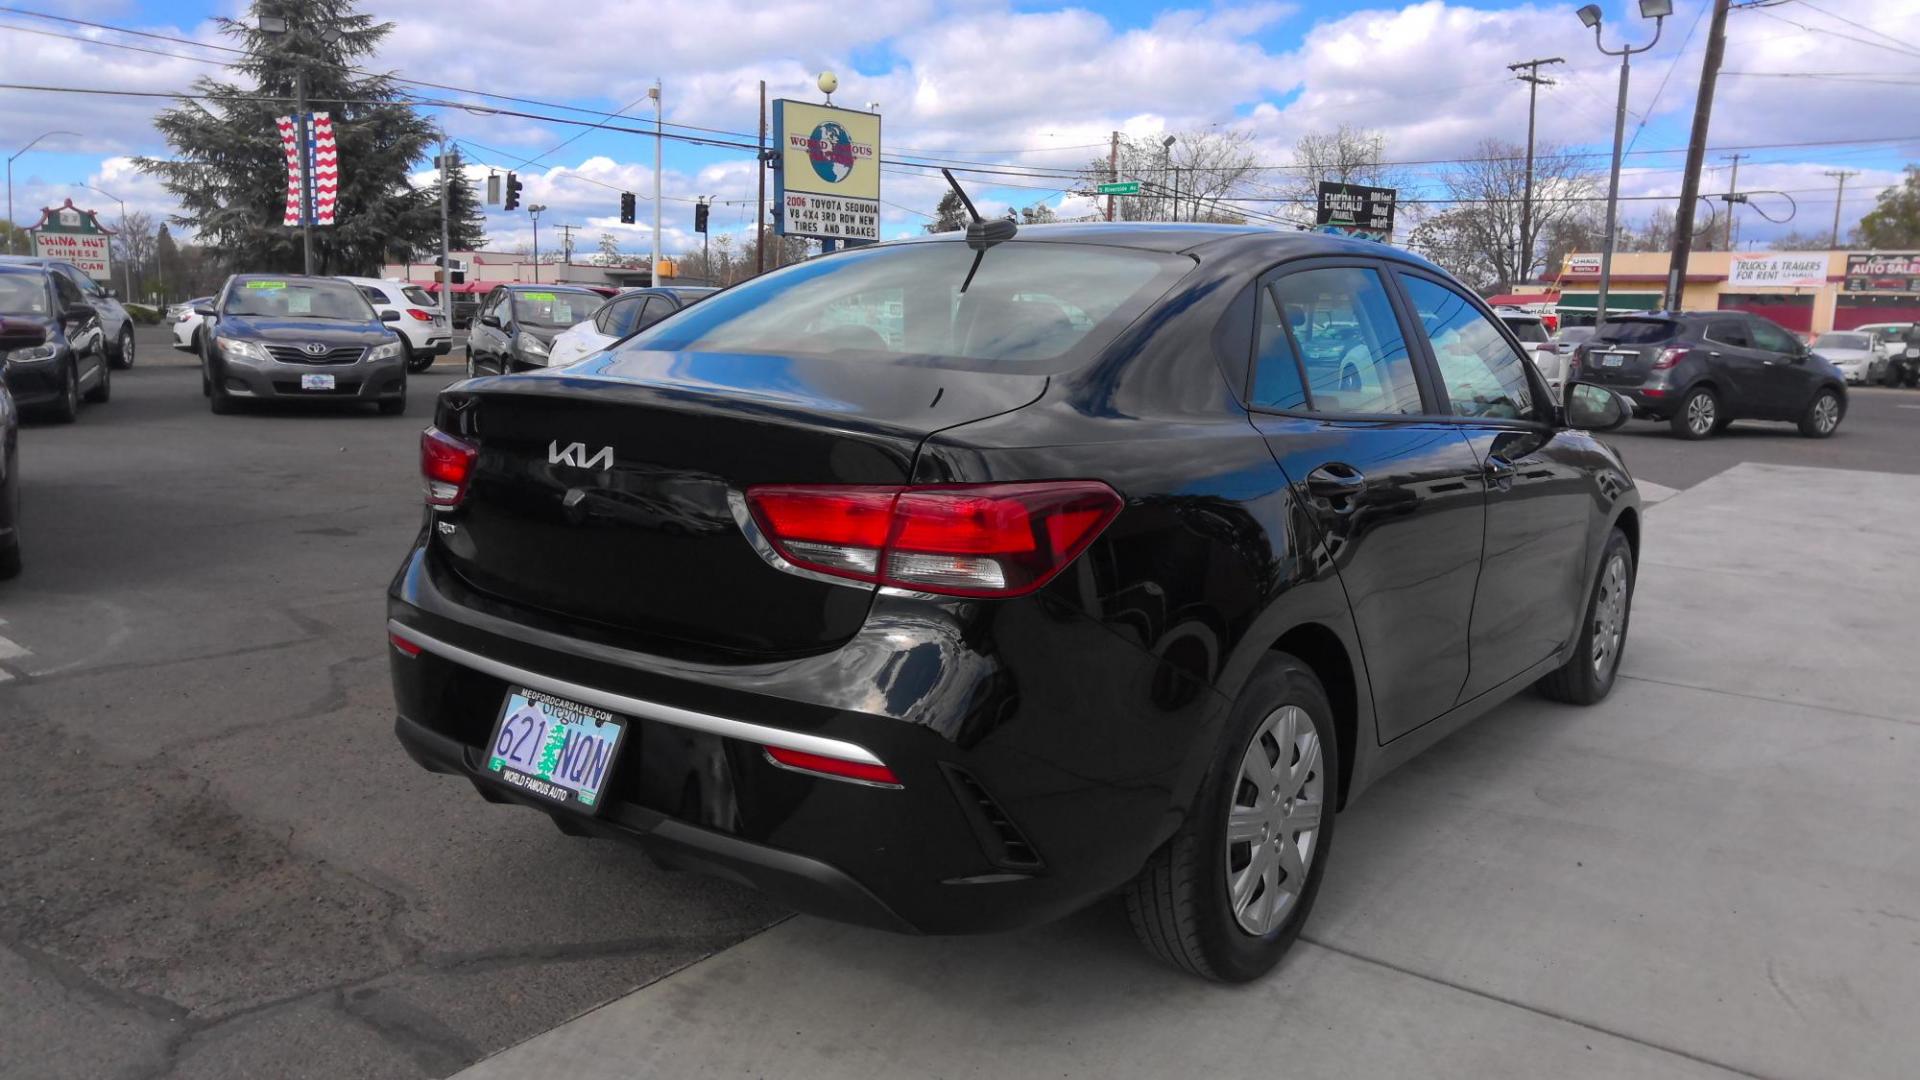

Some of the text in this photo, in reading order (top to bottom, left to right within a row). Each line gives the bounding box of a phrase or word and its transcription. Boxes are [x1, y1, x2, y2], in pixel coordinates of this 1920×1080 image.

[307, 120, 314, 141] WE
[309, 148, 317, 218] FINANCE
[786, 196, 878, 214] 2006 TOYOTA SEQUOIA
[1324, 193, 1363, 212] EMERALD
[789, 209, 875, 226] V8 4X4 3RD ROW NEW
[794, 221, 876, 237] TIRES AND BRAKES
[38, 235, 106, 248] CHINA HUT
[47, 249, 98, 258] CHINESE
[1736, 261, 1821, 271] TRUCKS & TRAILERS
[1851, 263, 1885, 274] AUTO
[1736, 271, 1753, 280] FOR
[1756, 271, 1779, 280] RENT
[549, 439, 614, 471] KIA
[521, 688, 613, 722] MEDFORDCARSALES.COM
[542, 703, 586, 727] Oregon
[496, 713, 612, 790] 621 NQN
[503, 770, 526, 787] WORLD
[524, 777, 551, 796] FAMOUS
[547, 786, 568, 802] AUTO
